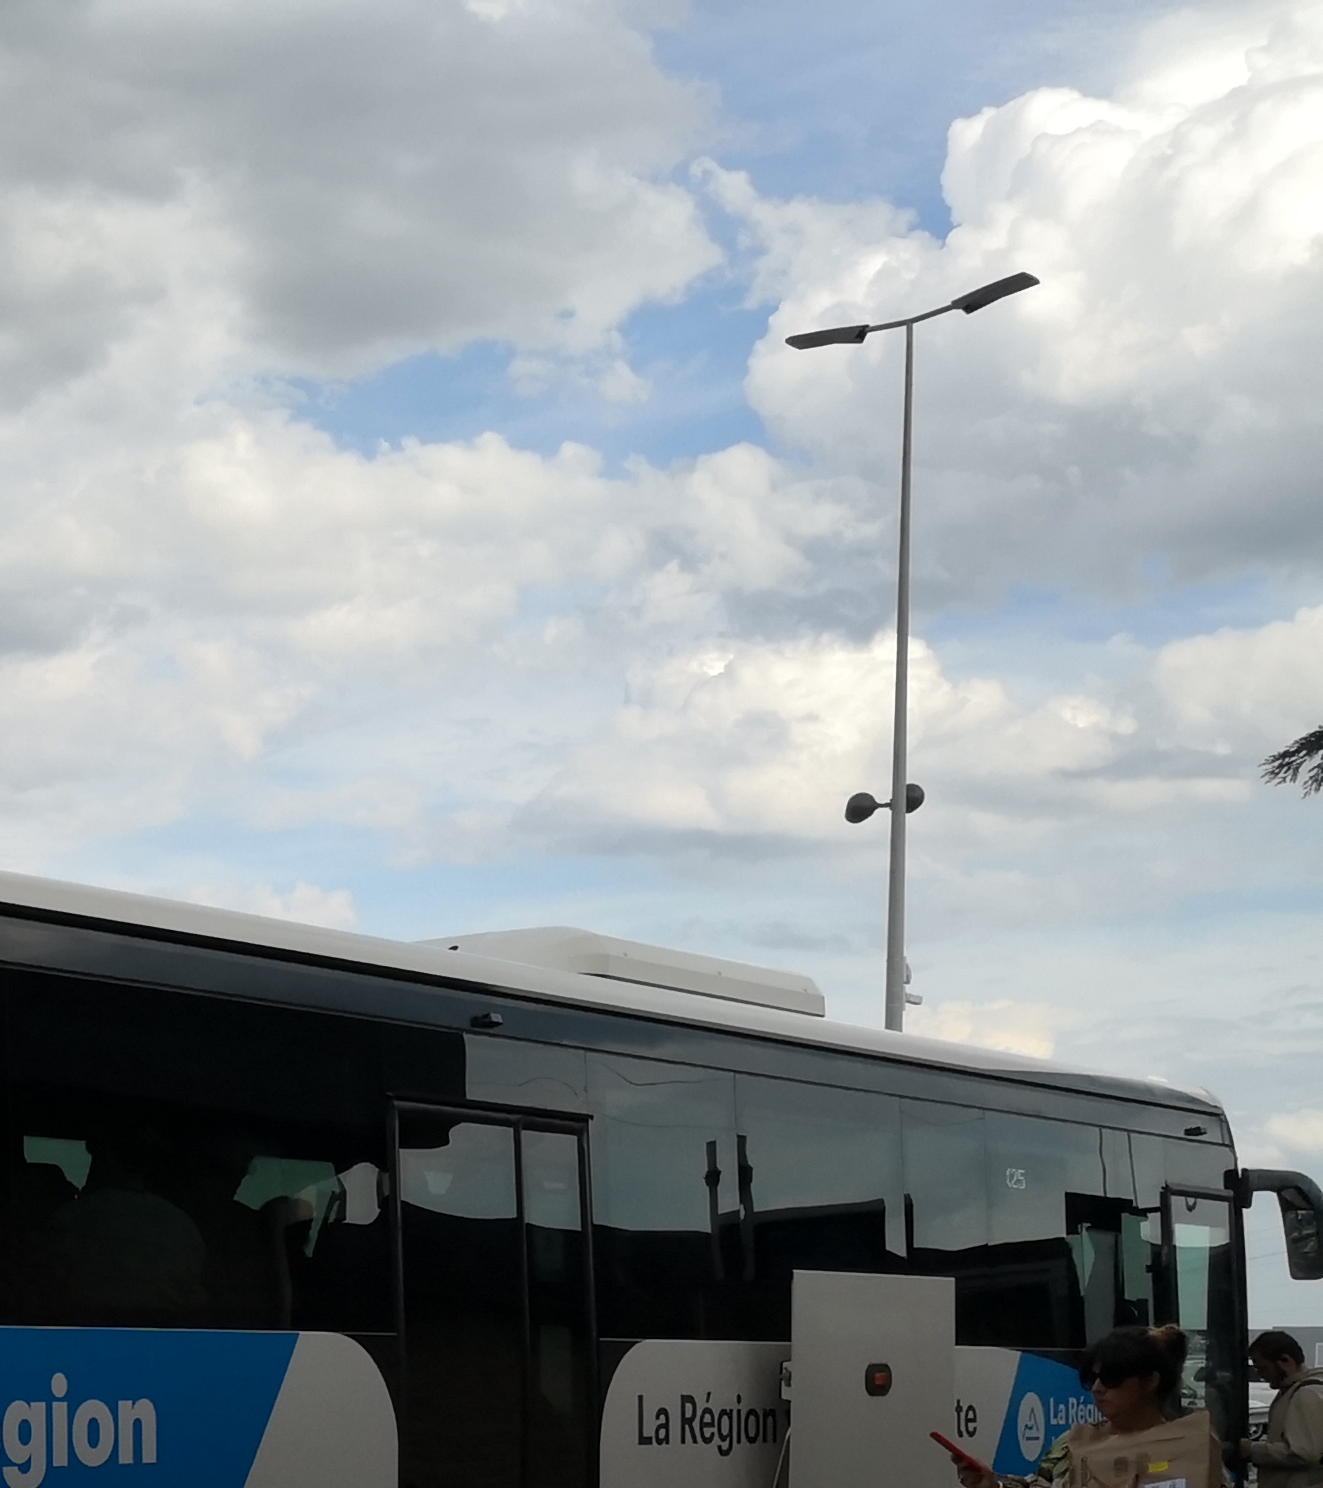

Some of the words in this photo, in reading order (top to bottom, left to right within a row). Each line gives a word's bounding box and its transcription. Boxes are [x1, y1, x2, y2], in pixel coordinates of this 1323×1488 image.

[638, 1394, 670, 1446] La
[680, 1391, 777, 1457] Région
[1050, 1397, 1066, 1425] La
